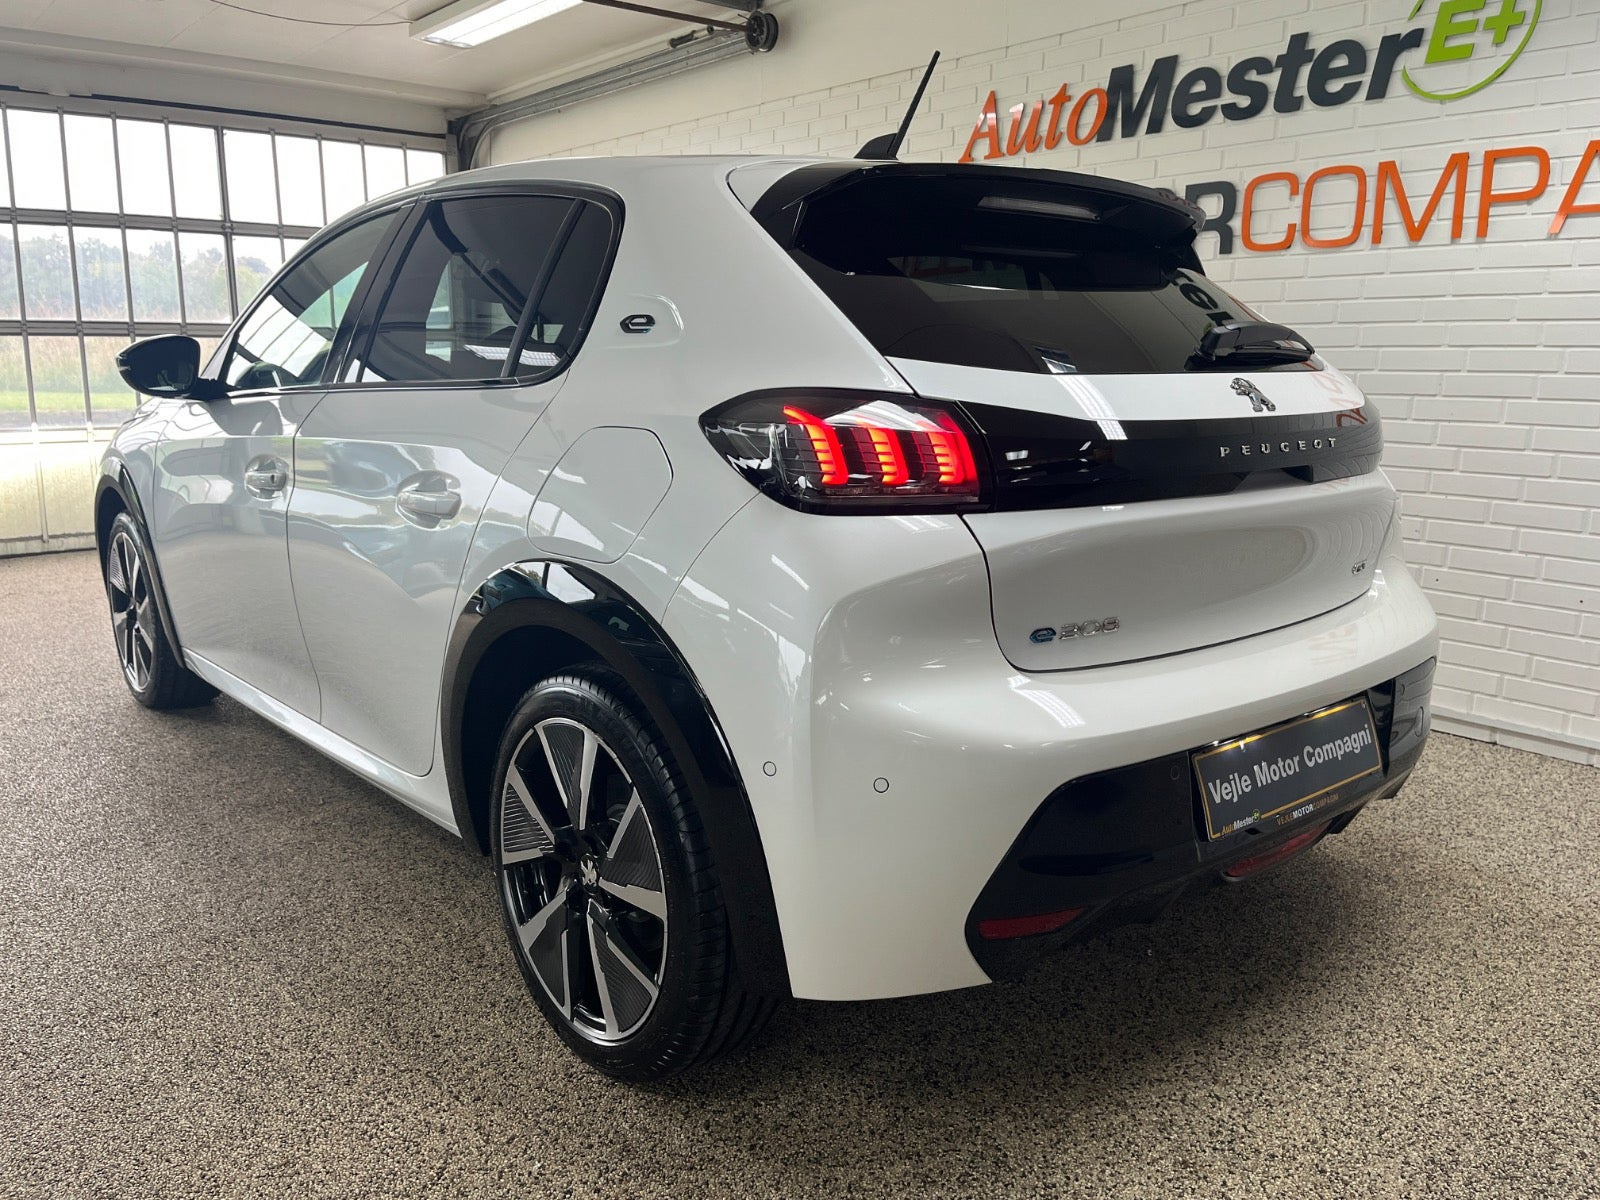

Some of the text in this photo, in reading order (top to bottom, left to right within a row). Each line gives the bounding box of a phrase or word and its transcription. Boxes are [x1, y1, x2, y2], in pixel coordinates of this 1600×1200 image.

[958, 27, 1425, 163] AutoMester
[1219, 437, 1336, 457] PEUGEOT
[1208, 723, 1372, 804] Vejle Motor Compagni
